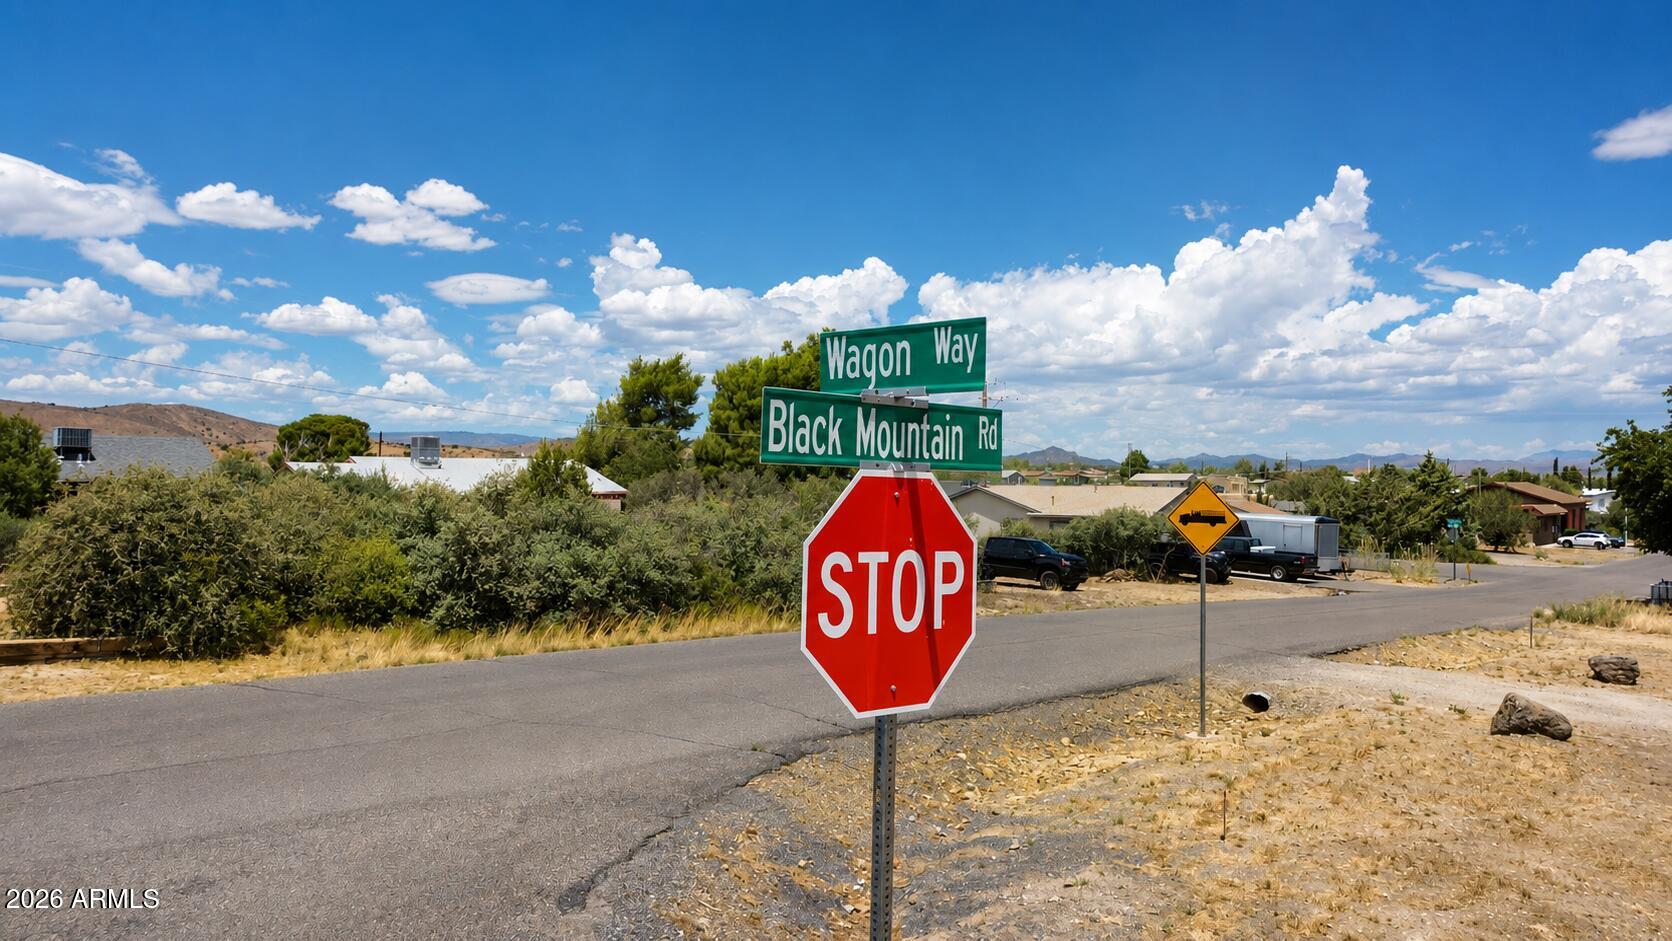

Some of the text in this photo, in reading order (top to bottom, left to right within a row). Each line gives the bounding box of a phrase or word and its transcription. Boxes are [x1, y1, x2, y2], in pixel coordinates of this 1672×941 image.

[826, 326, 978, 389] Wagon Way
[768, 399, 998, 461] Black Mountain Rd
[818, 549, 965, 639] STOP
